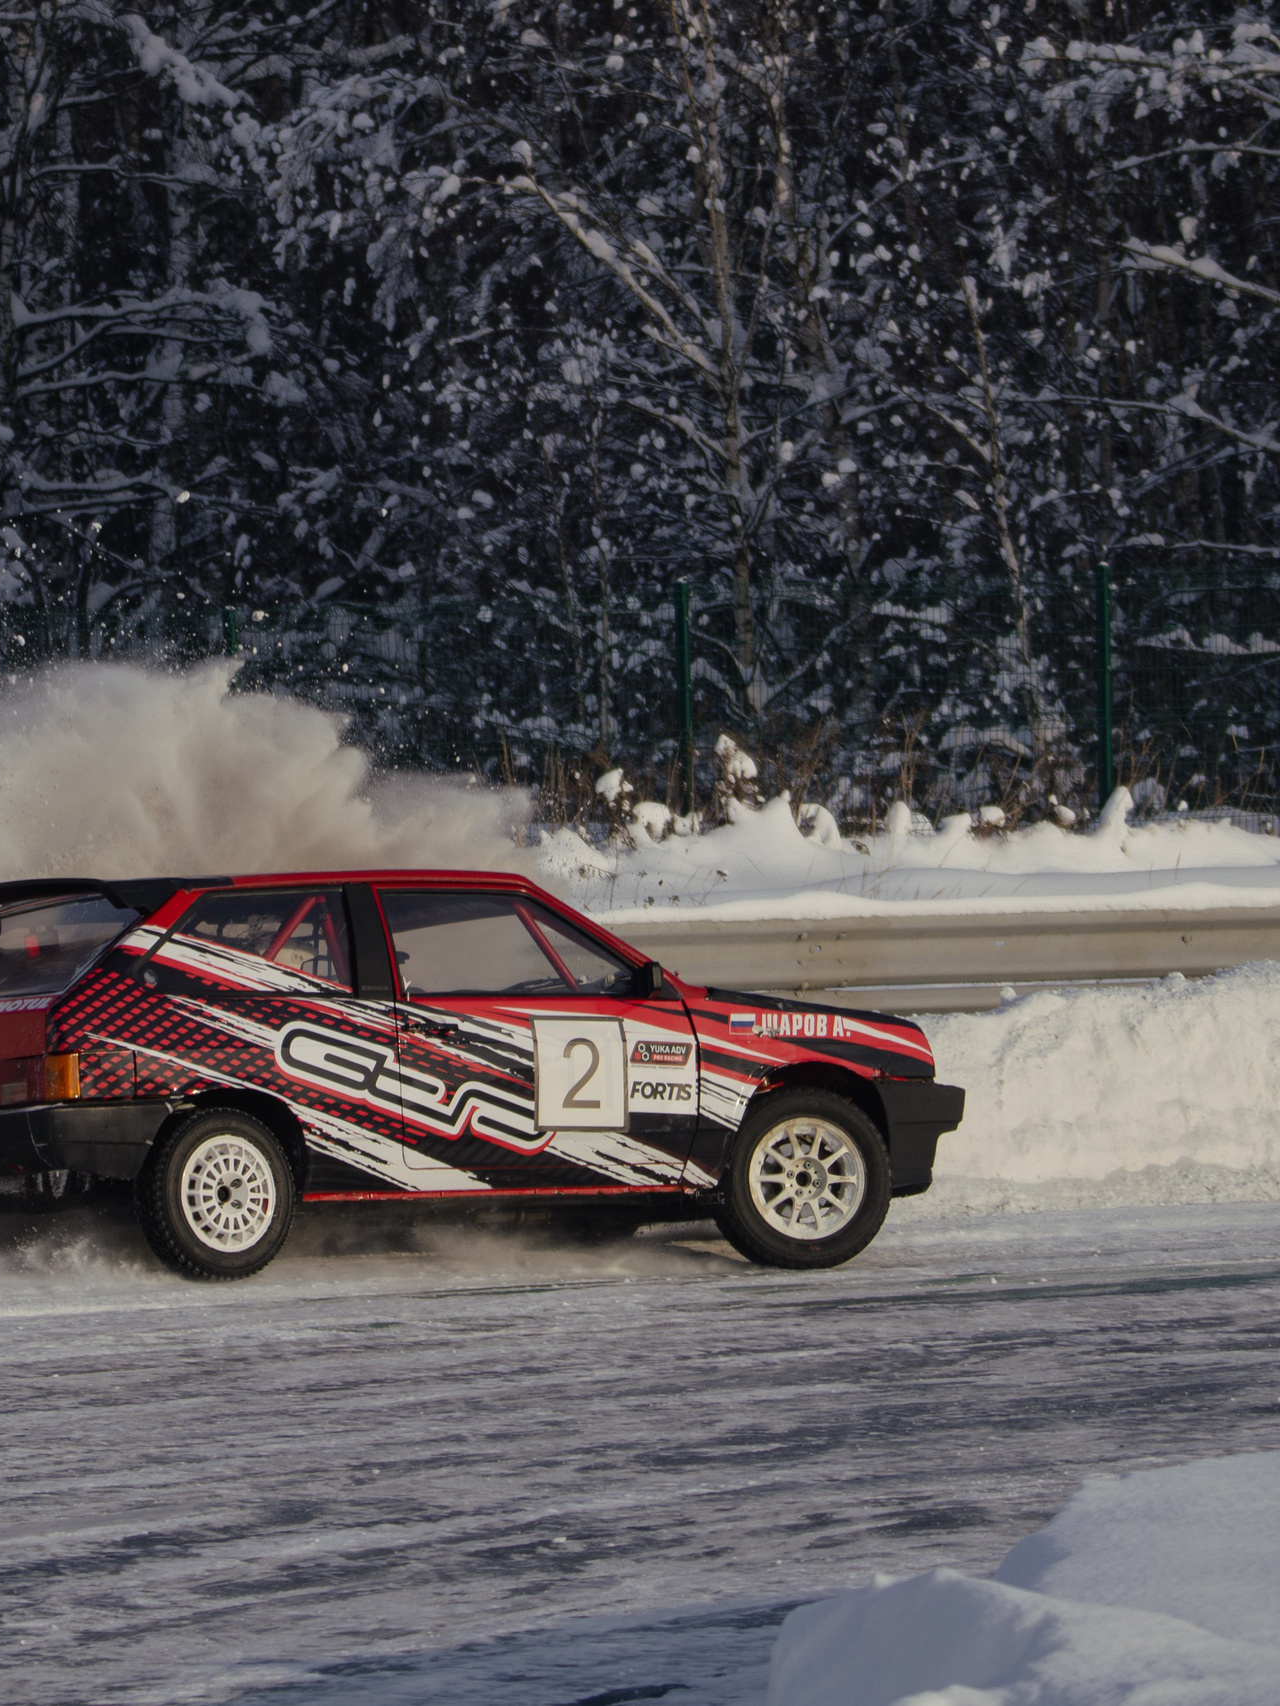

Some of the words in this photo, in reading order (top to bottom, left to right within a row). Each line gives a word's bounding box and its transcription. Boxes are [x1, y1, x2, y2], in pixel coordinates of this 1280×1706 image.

[761, 1013, 828, 1037] ШАРОВ
[650, 1044, 670, 1053] YUKA
[670, 1045, 687, 1054] ADV
[562, 1037, 601, 1109] 2
[630, 1081, 693, 1101] FORTIS
